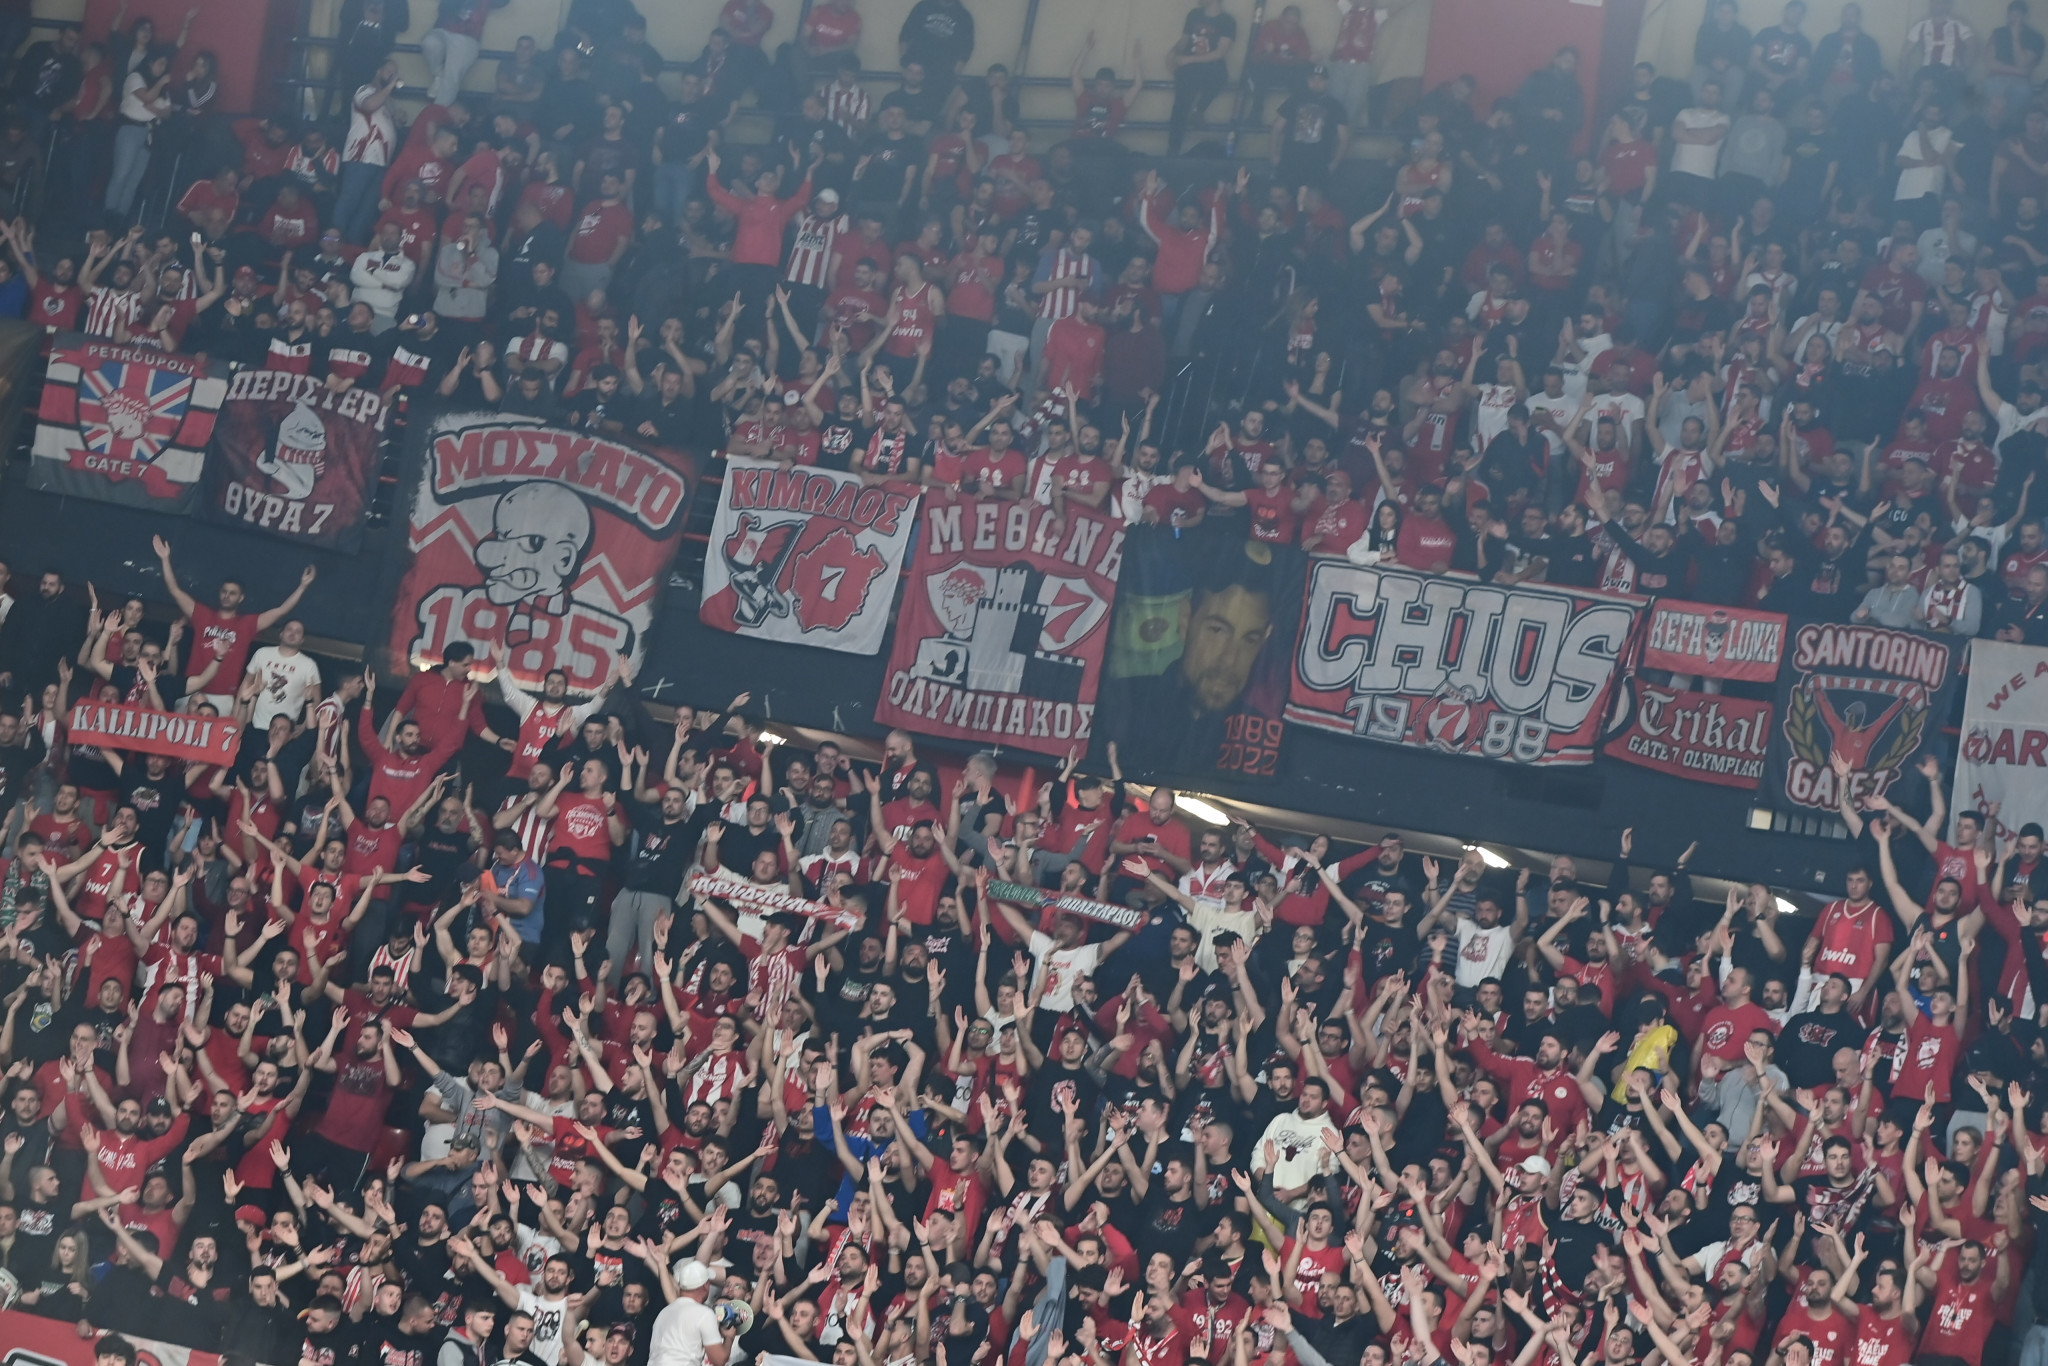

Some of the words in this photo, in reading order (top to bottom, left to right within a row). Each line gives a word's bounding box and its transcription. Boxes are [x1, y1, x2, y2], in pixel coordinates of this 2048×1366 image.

[89, 344, 195, 376] PETROUPOLI
[84, 454, 132, 475] GATE
[136, 462, 148, 478] 7
[434, 427, 686, 528] ΜΟΣΧΑΤΟ
[225, 482, 301, 534] ΘΥΡΑ
[308, 504, 335, 534] 7
[731, 467, 909, 538] ΚΙΜΩΛΟΣ
[820, 564, 847, 602] 7
[1043, 582, 1094, 644] 7
[418, 594, 620, 690] 1985
[1300, 560, 1636, 734] CHIOS
[1797, 626, 1945, 686] SANTORINI
[888, 669, 1095, 740] ΟΛΥΜΠΙΑΚΟΣ
[1986, 671, 2027, 711] WE
[71, 703, 213, 749] KALLIPOLI
[221, 725, 239, 752] 7
[1224, 713, 1283, 748] 1989
[1640, 688, 1768, 756] Trikal
[522, 743, 543, 758] bw
[1217, 743, 1280, 776] 2022
[1628, 734, 1669, 761] GATE
[1671, 746, 1681, 763] 7
[1682, 749, 1765, 779] OLYMPIAK
[1791, 761, 1869, 808] GAE
[85, 878, 111, 895] bwi
[101, 862, 113, 877] 7
[1821, 946, 1857, 965] bwin
